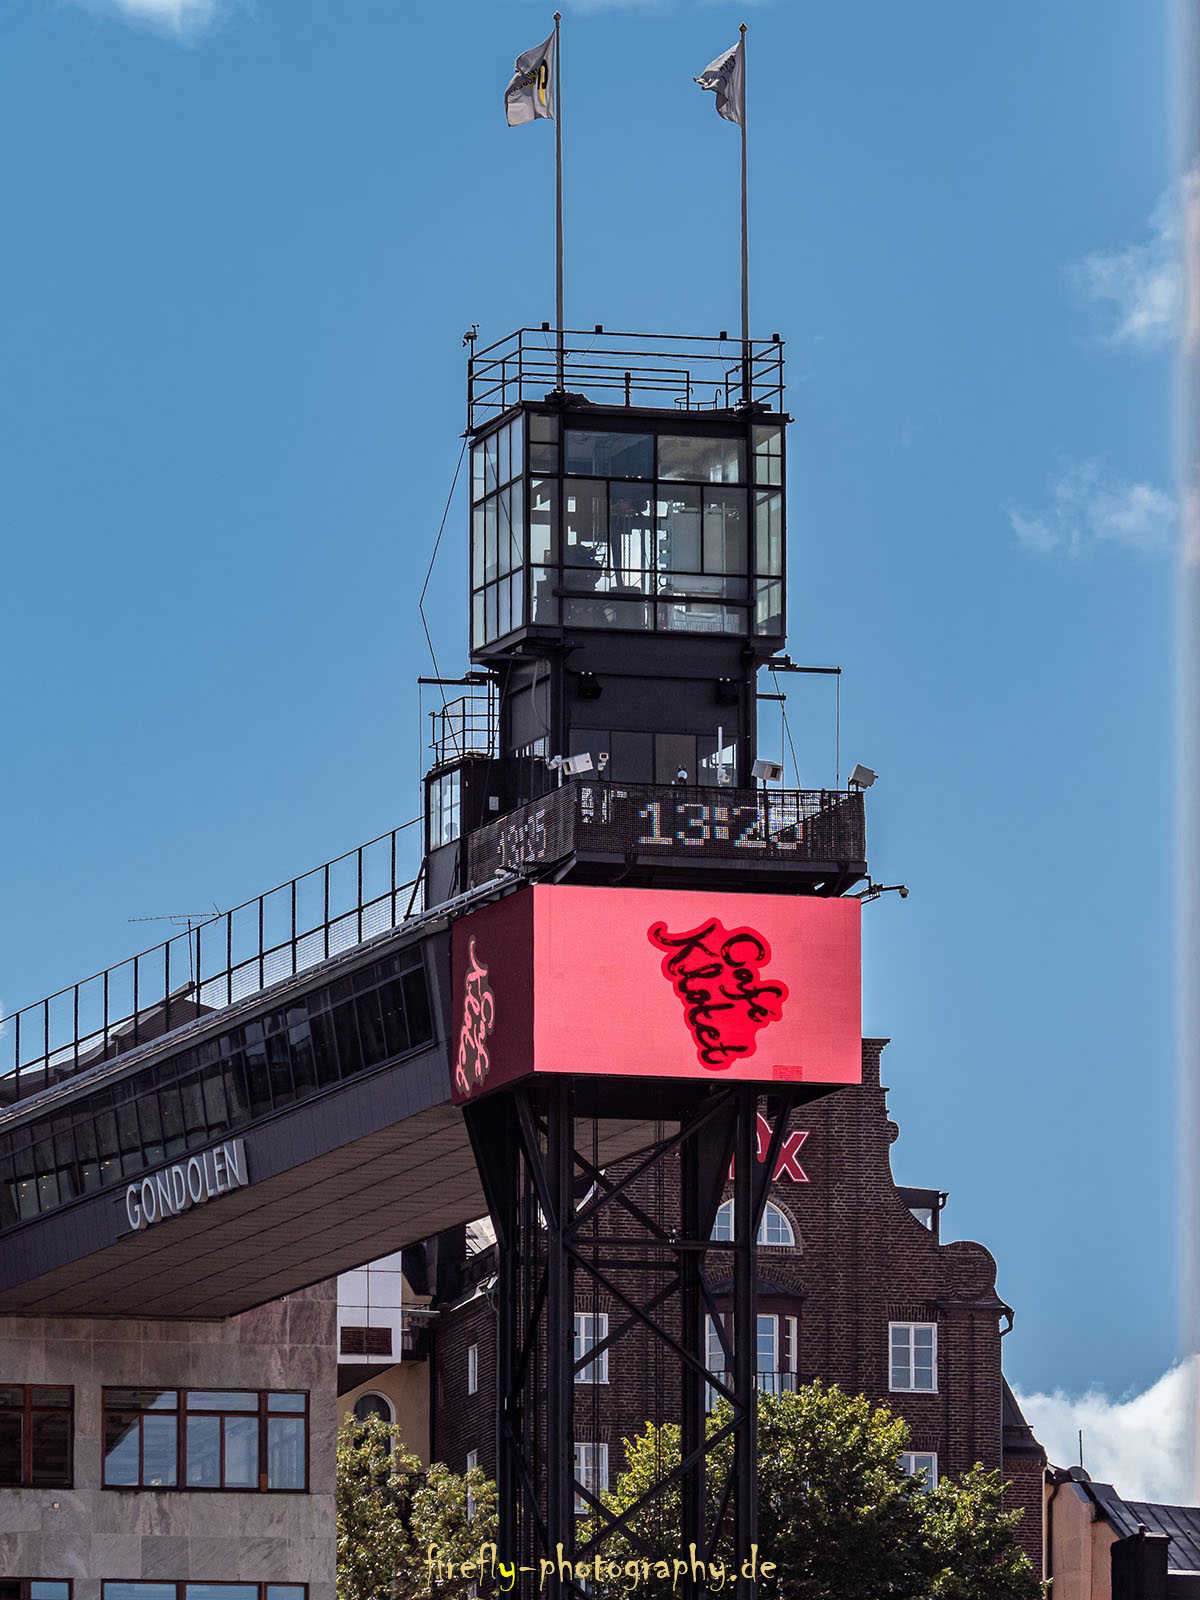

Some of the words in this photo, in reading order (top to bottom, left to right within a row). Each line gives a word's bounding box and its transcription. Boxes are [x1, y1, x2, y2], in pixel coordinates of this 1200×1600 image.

[653, 923, 749, 1065] Klotet
[719, 933, 782, 1023] Café
[126, 1138, 249, 1230] GONDOLEN
